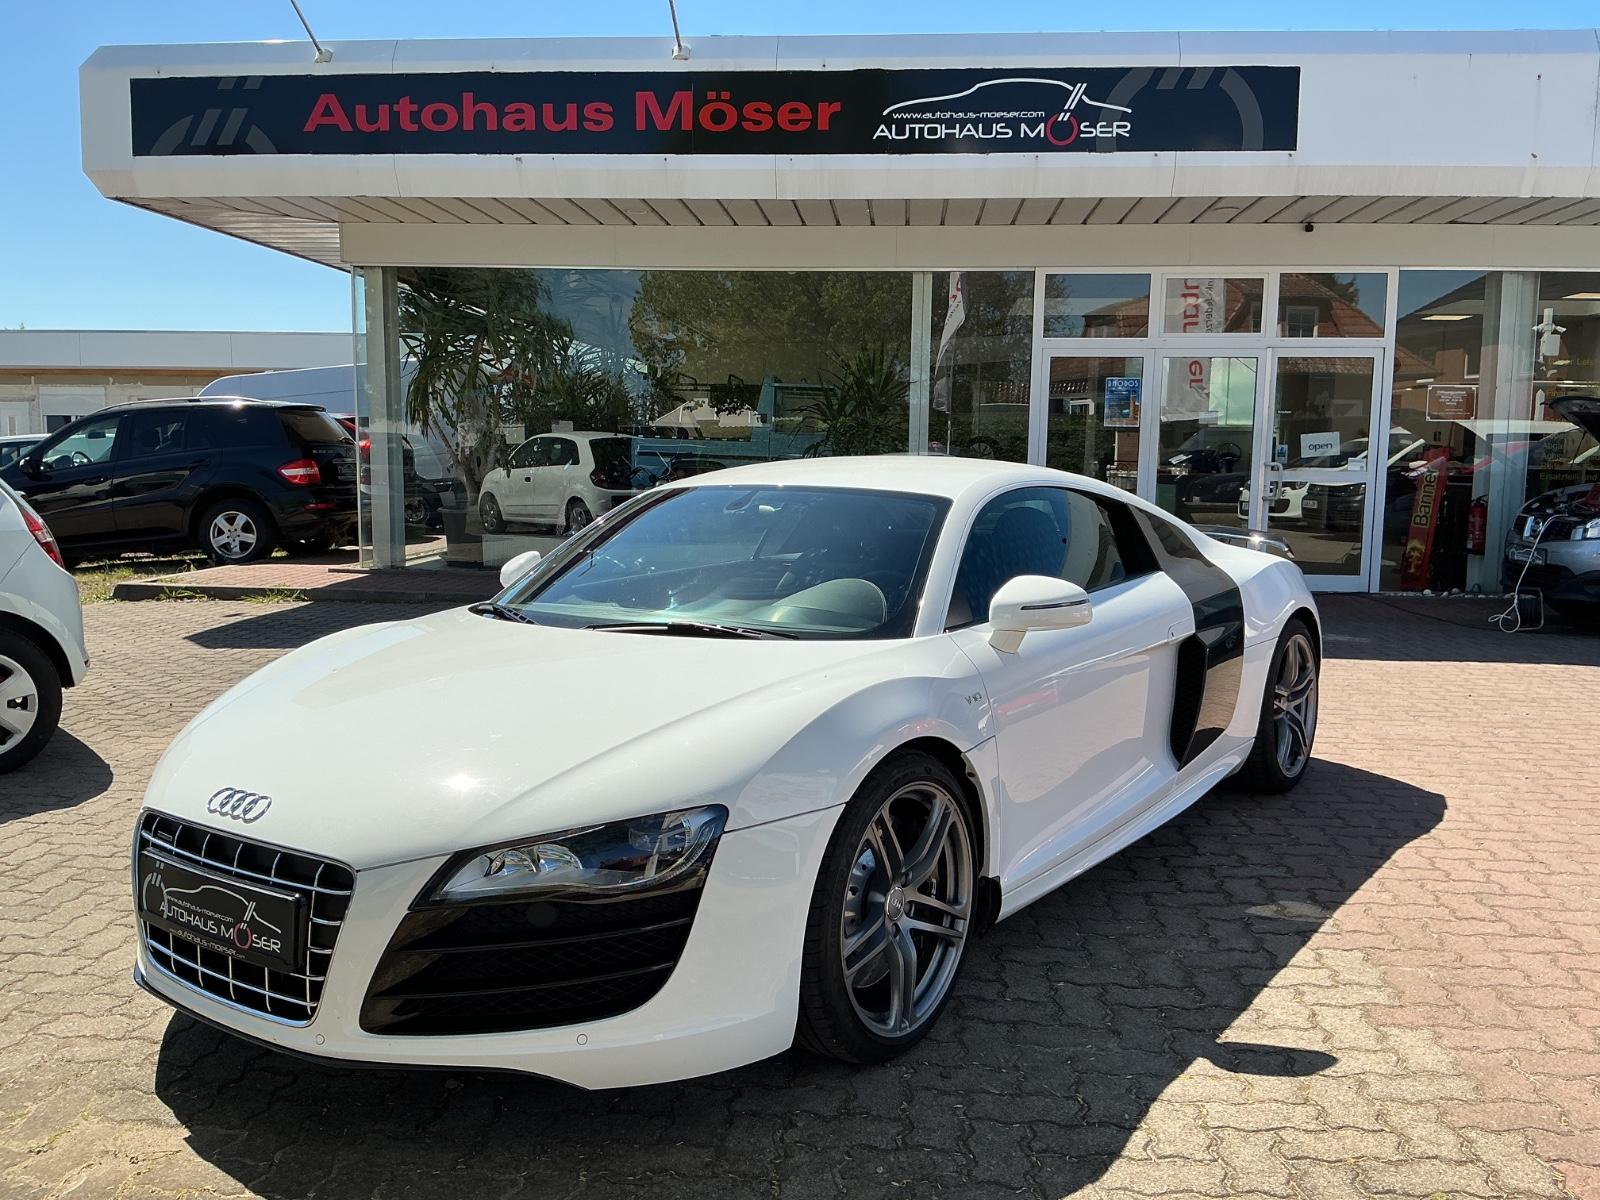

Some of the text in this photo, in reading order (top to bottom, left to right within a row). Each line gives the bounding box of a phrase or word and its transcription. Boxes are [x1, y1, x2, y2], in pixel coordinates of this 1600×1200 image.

[303, 91, 842, 133] Autohaus Möser
[892, 111, 1045, 119] www.autohaus-moeser.com
[873, 113, 1132, 146] AUTOHAUS MÖSER
[1308, 441, 1333, 452] open
[160, 901, 282, 953] AUTOHAUS MÖSER
